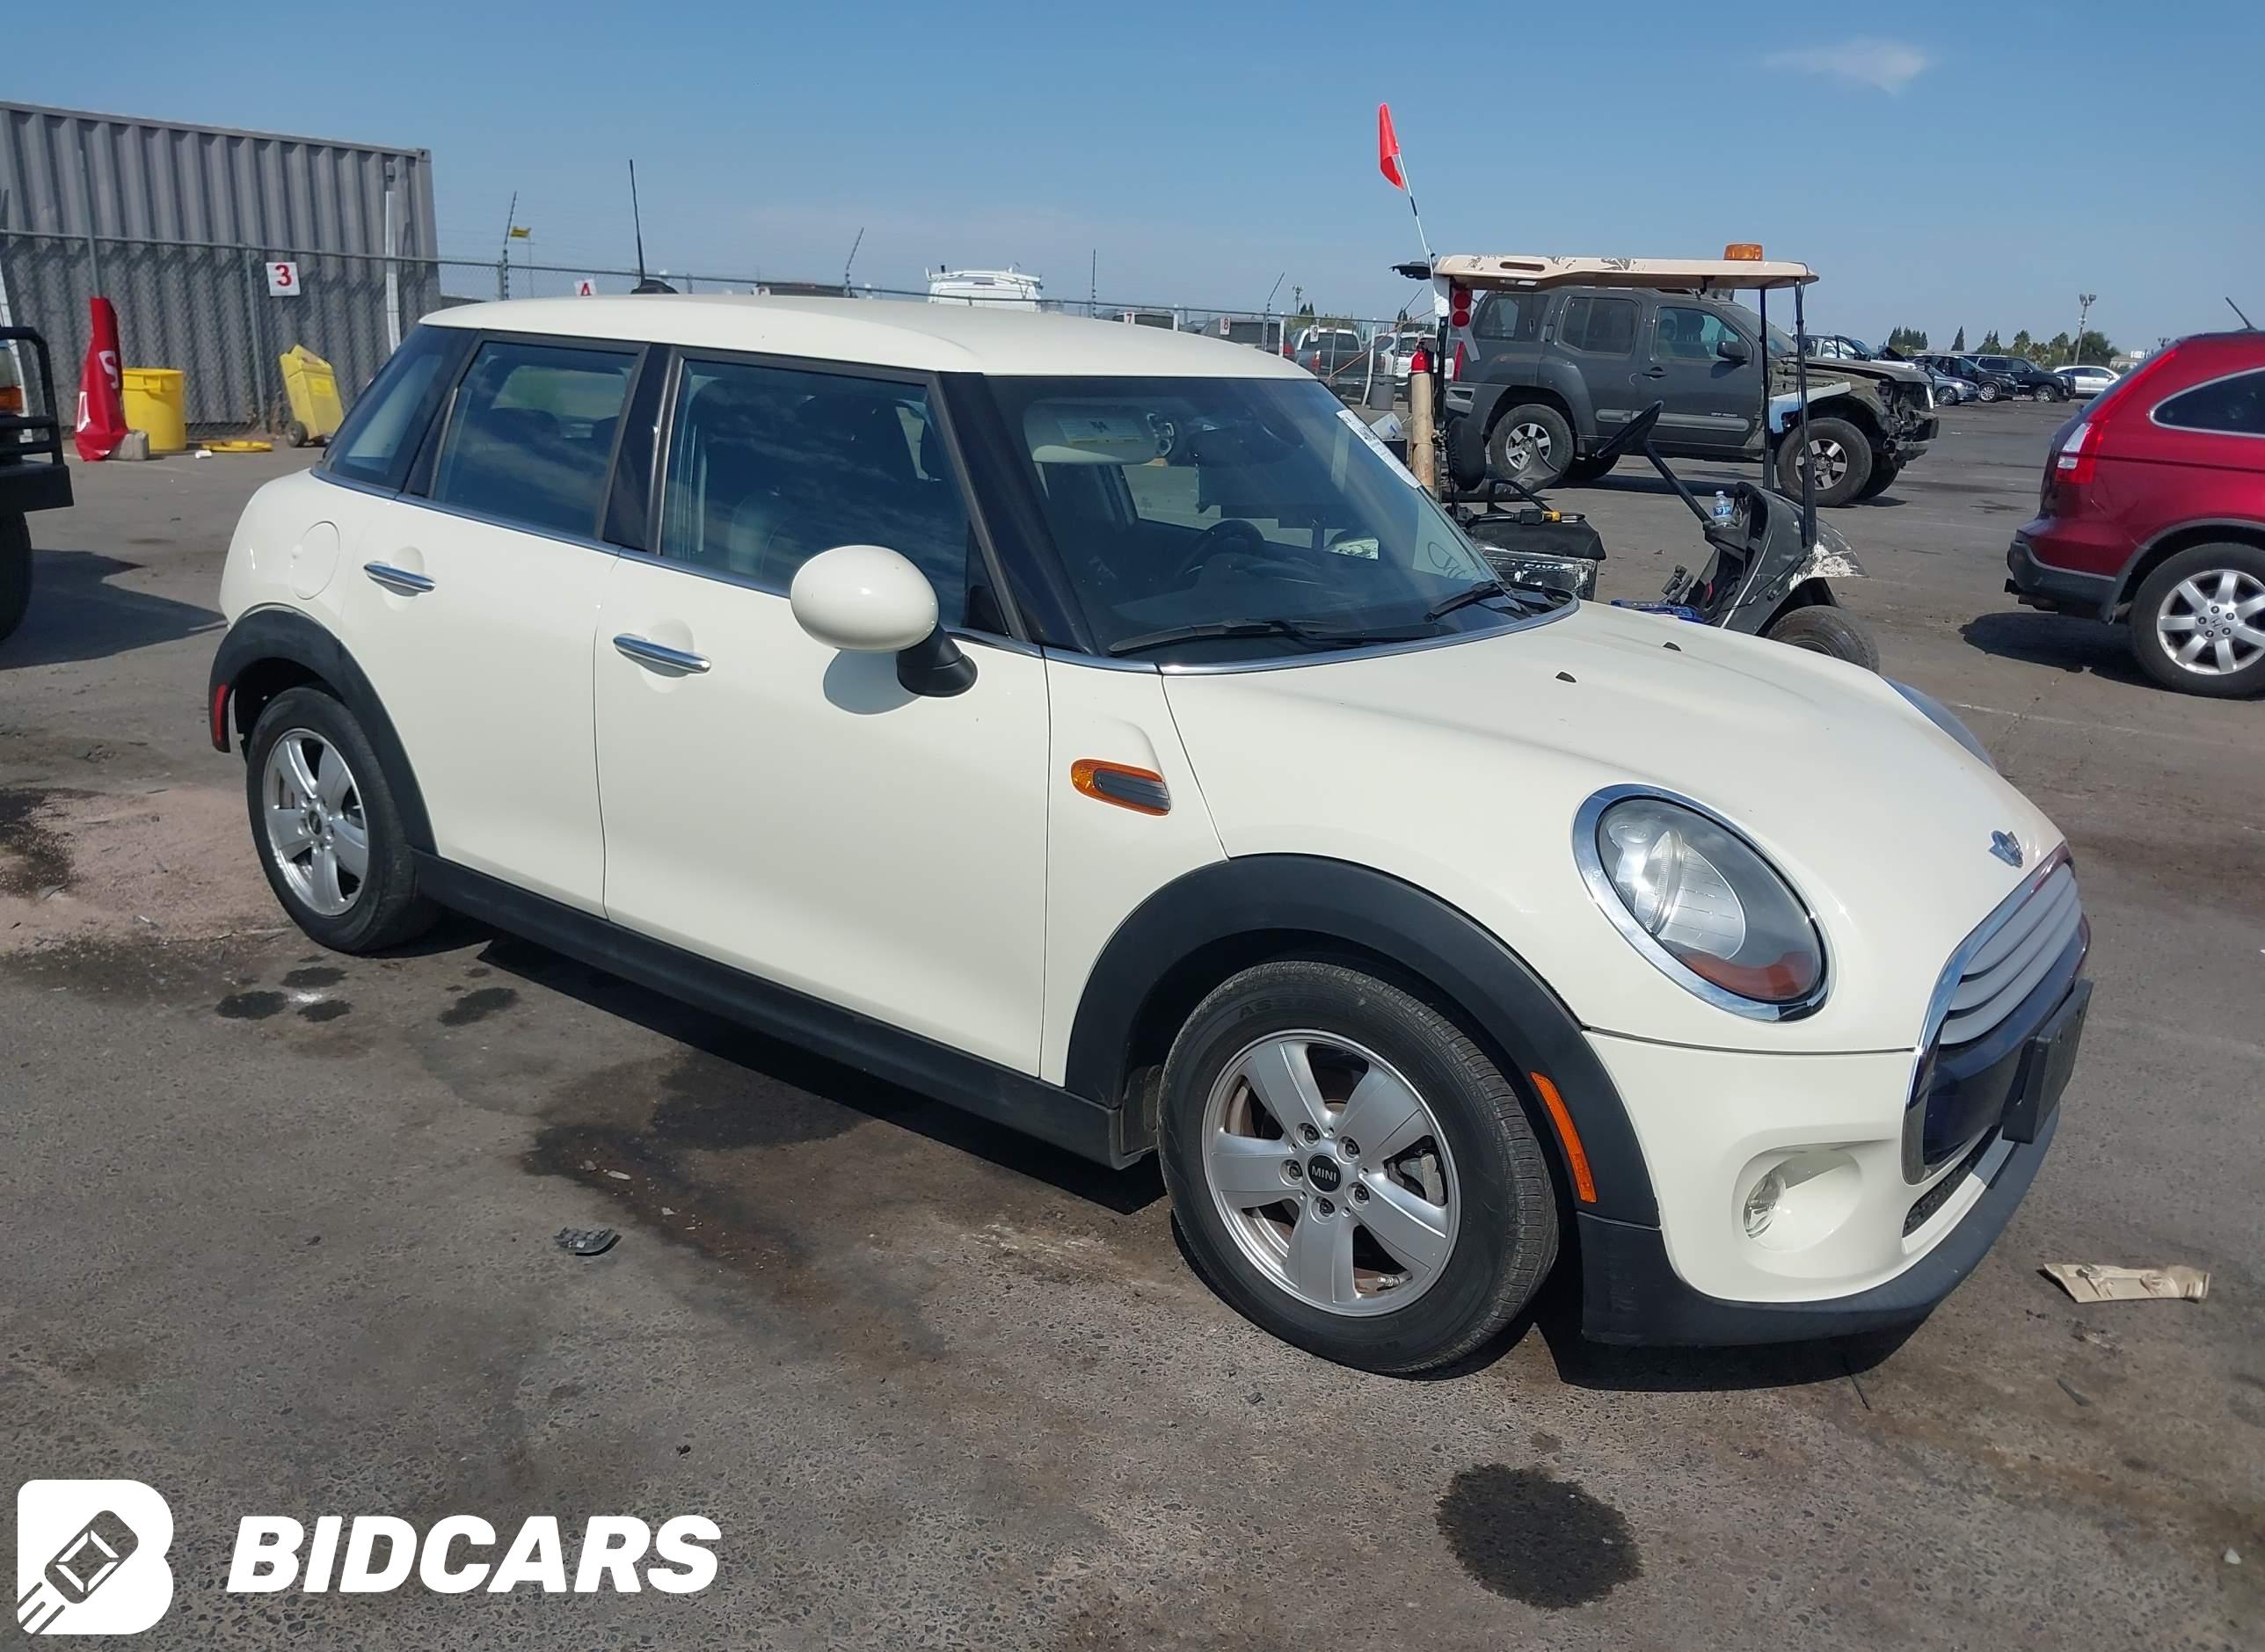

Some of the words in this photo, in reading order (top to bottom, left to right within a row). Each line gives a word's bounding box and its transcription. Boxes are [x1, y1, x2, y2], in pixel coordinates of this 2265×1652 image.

[275, 265, 292, 287] 3
[1223, 317, 1229, 331] 8
[1311, 1165, 1337, 1183] MINI
